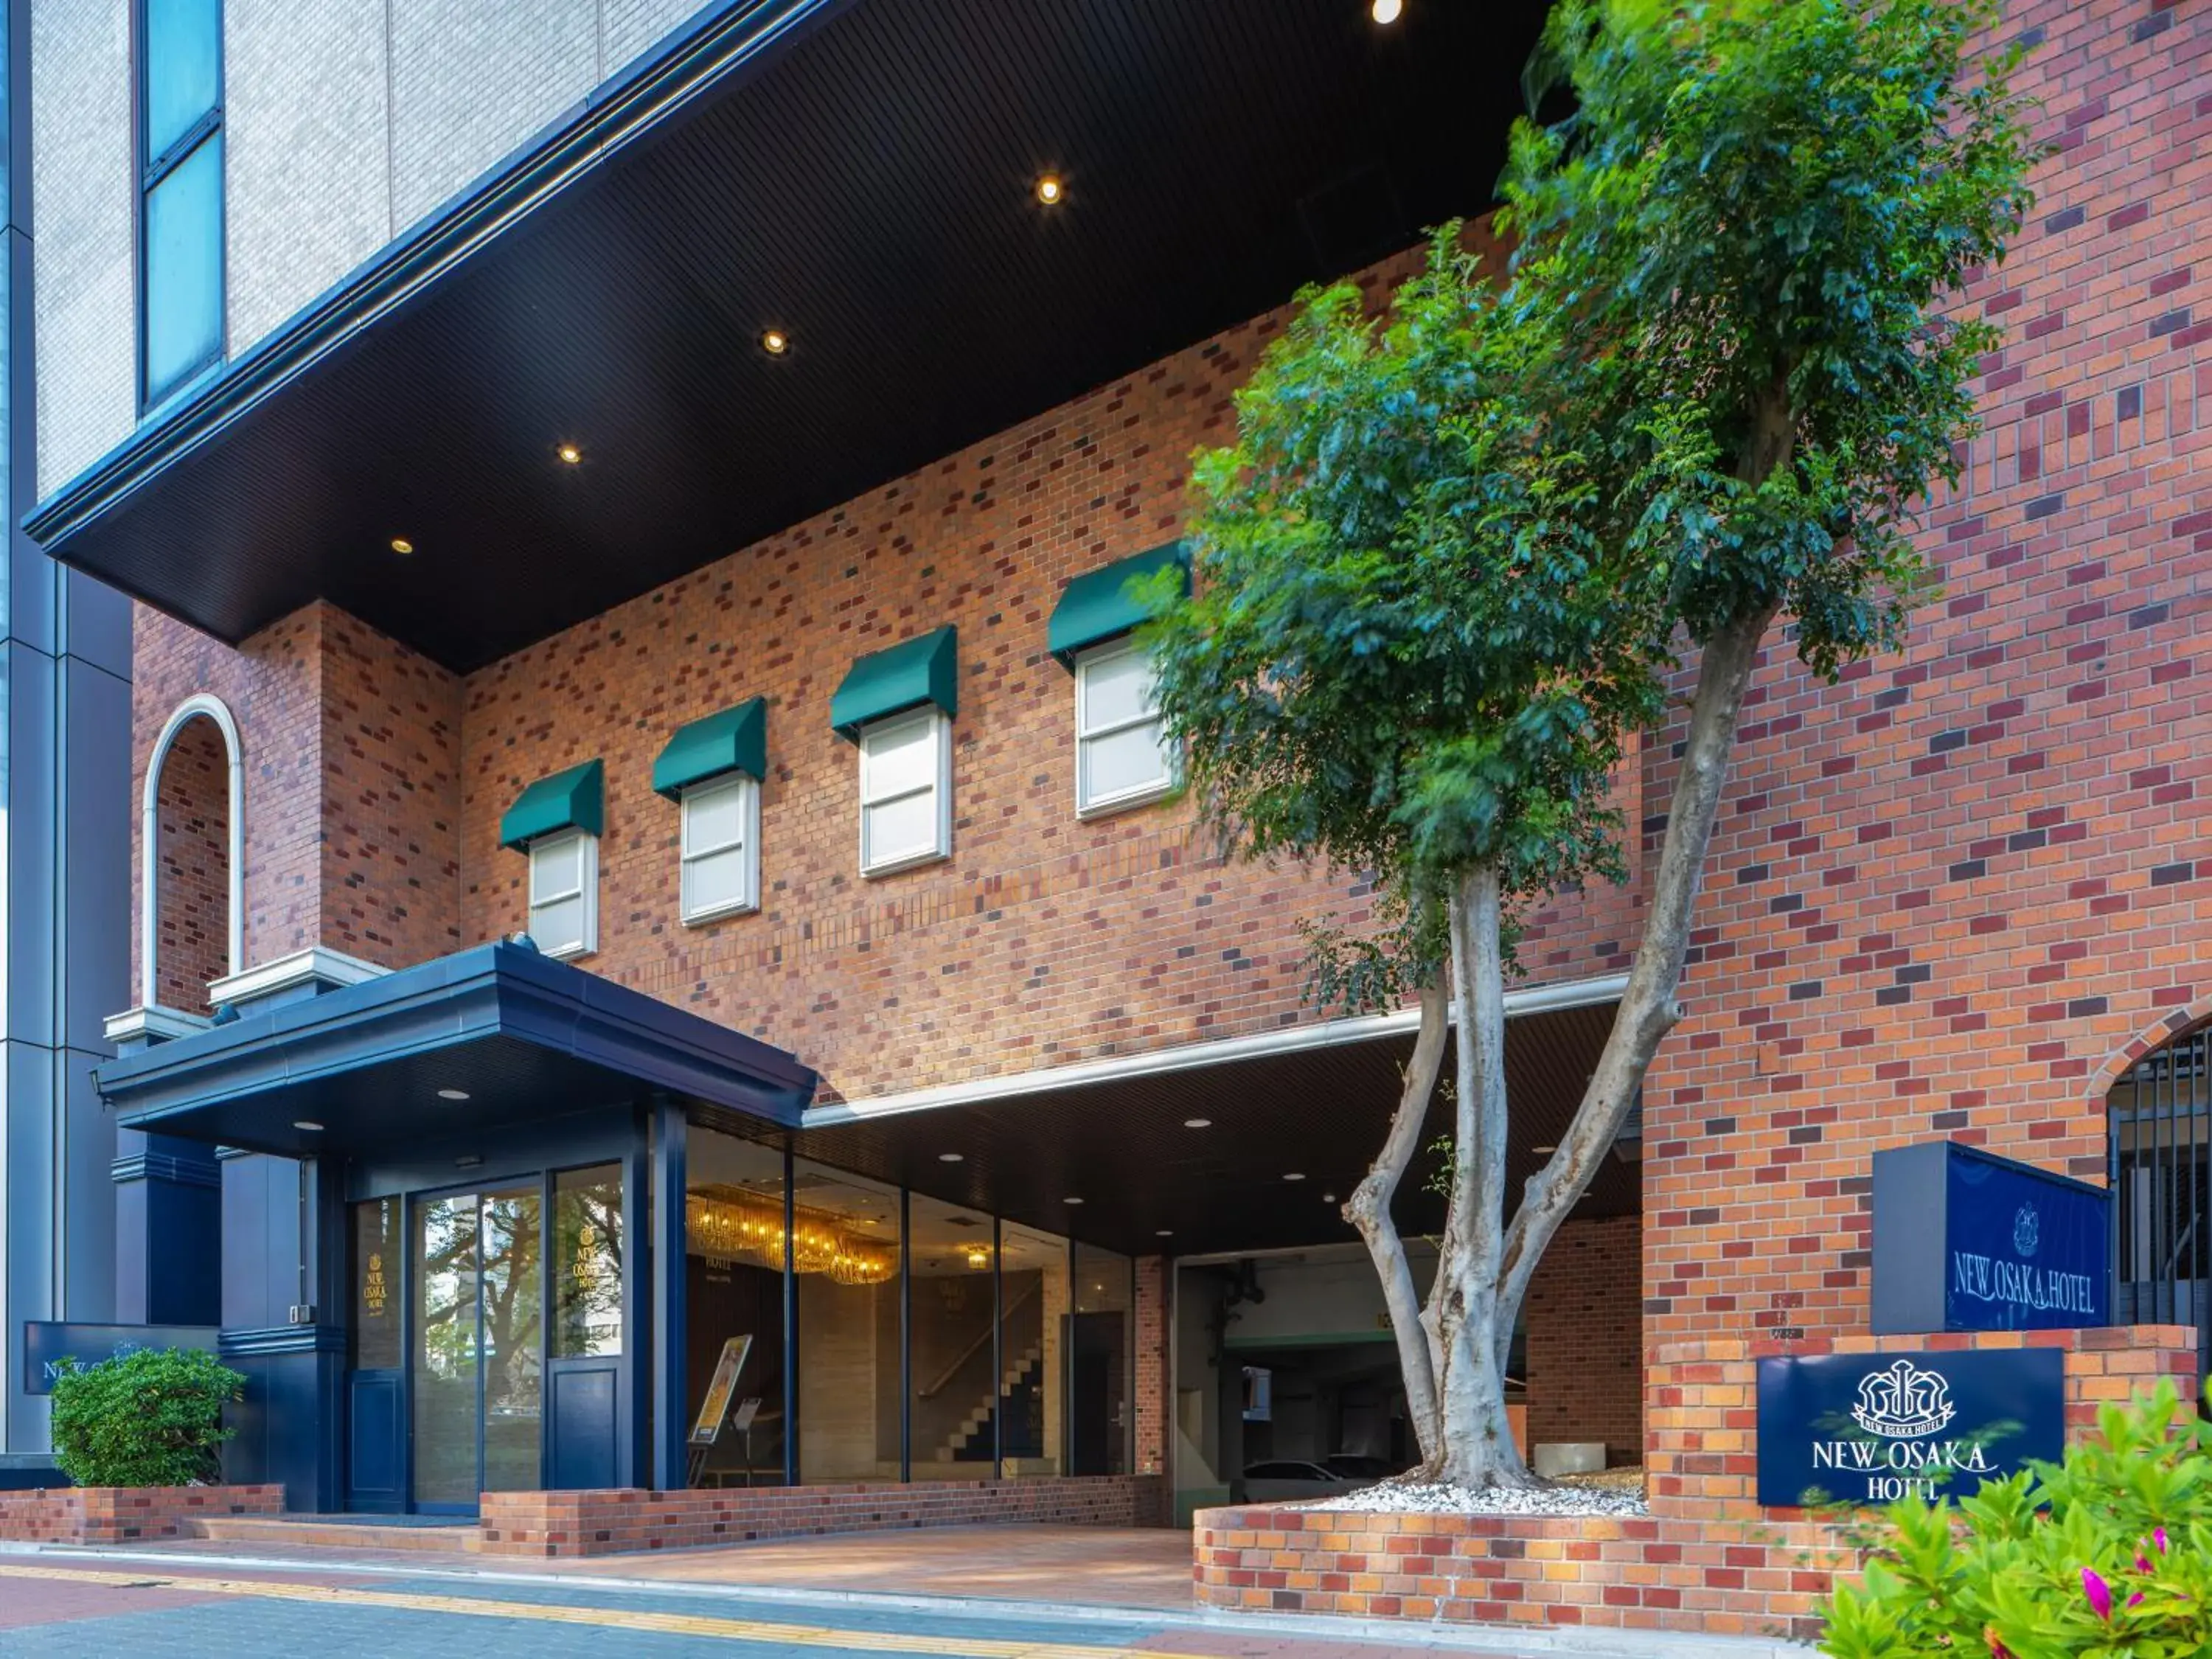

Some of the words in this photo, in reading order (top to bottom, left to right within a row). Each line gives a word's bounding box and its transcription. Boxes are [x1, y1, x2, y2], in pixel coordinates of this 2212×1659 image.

[1955, 1251, 1995, 1301] NEW
[1994, 1260, 2051, 1310] OSAKA
[2048, 1270, 2095, 1313] HOTEL
[1865, 1419, 1883, 1433] NEW
[1884, 1425, 1913, 1435] OSAKA
[1915, 1419, 1940, 1434] HOTEL
[1812, 1441, 1888, 1472] NEW
[1888, 1441, 2000, 1472] OSAKA
[1868, 1477, 1939, 1500] HOTEL
